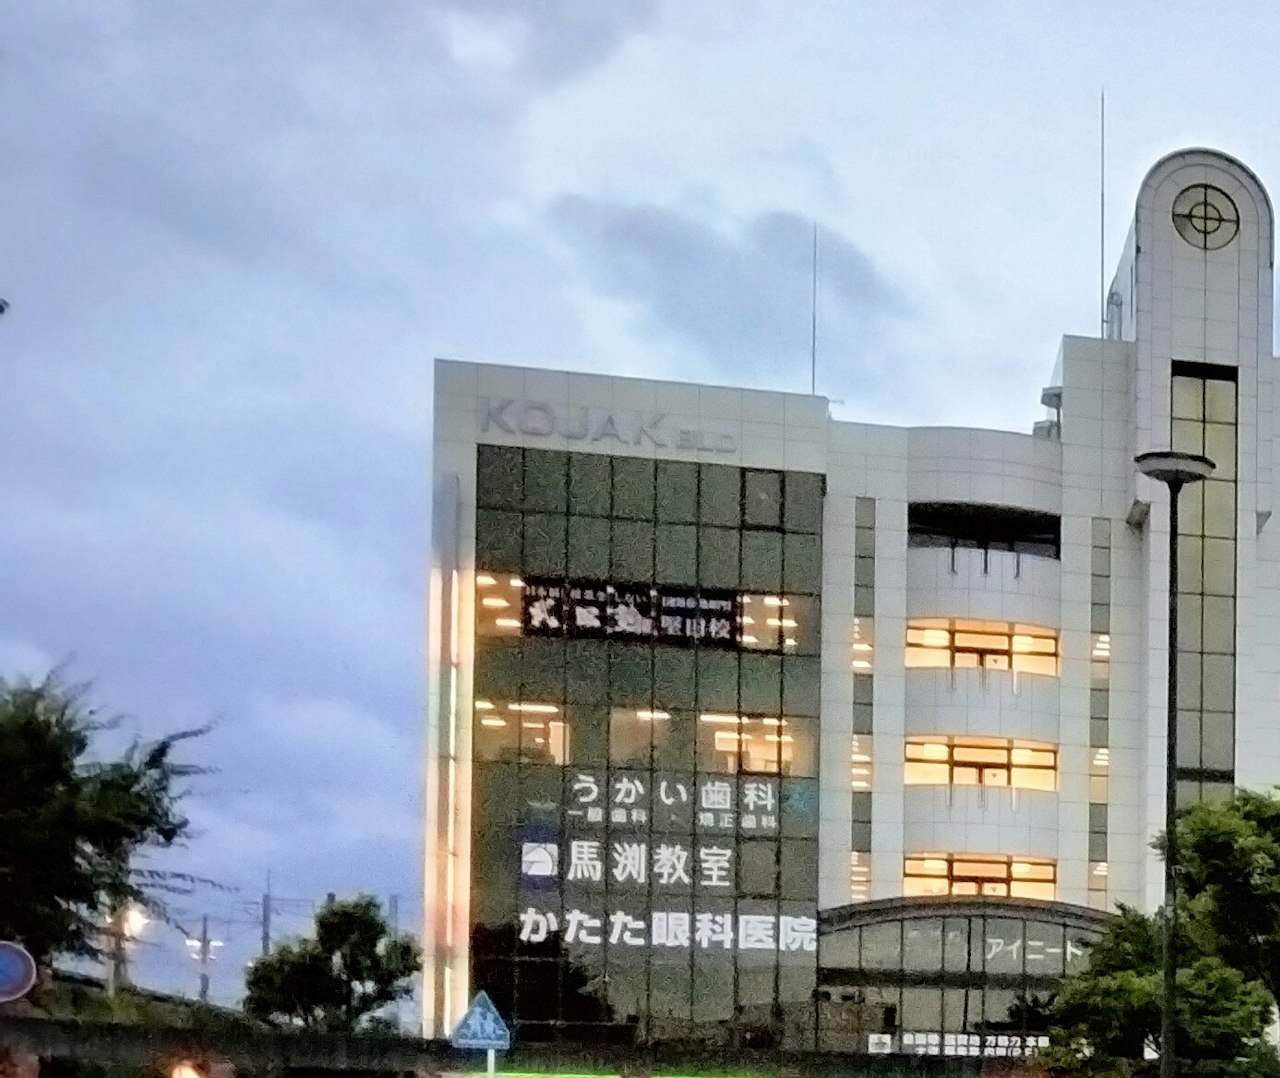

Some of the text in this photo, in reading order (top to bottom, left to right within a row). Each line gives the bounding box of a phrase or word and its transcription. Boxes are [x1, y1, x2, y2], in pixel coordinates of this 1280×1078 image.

[482, 399, 667, 448] KOJAK
[574, 774, 775, 812] うかい歯科
[519, 907, 817, 951] かたた眼科医院
